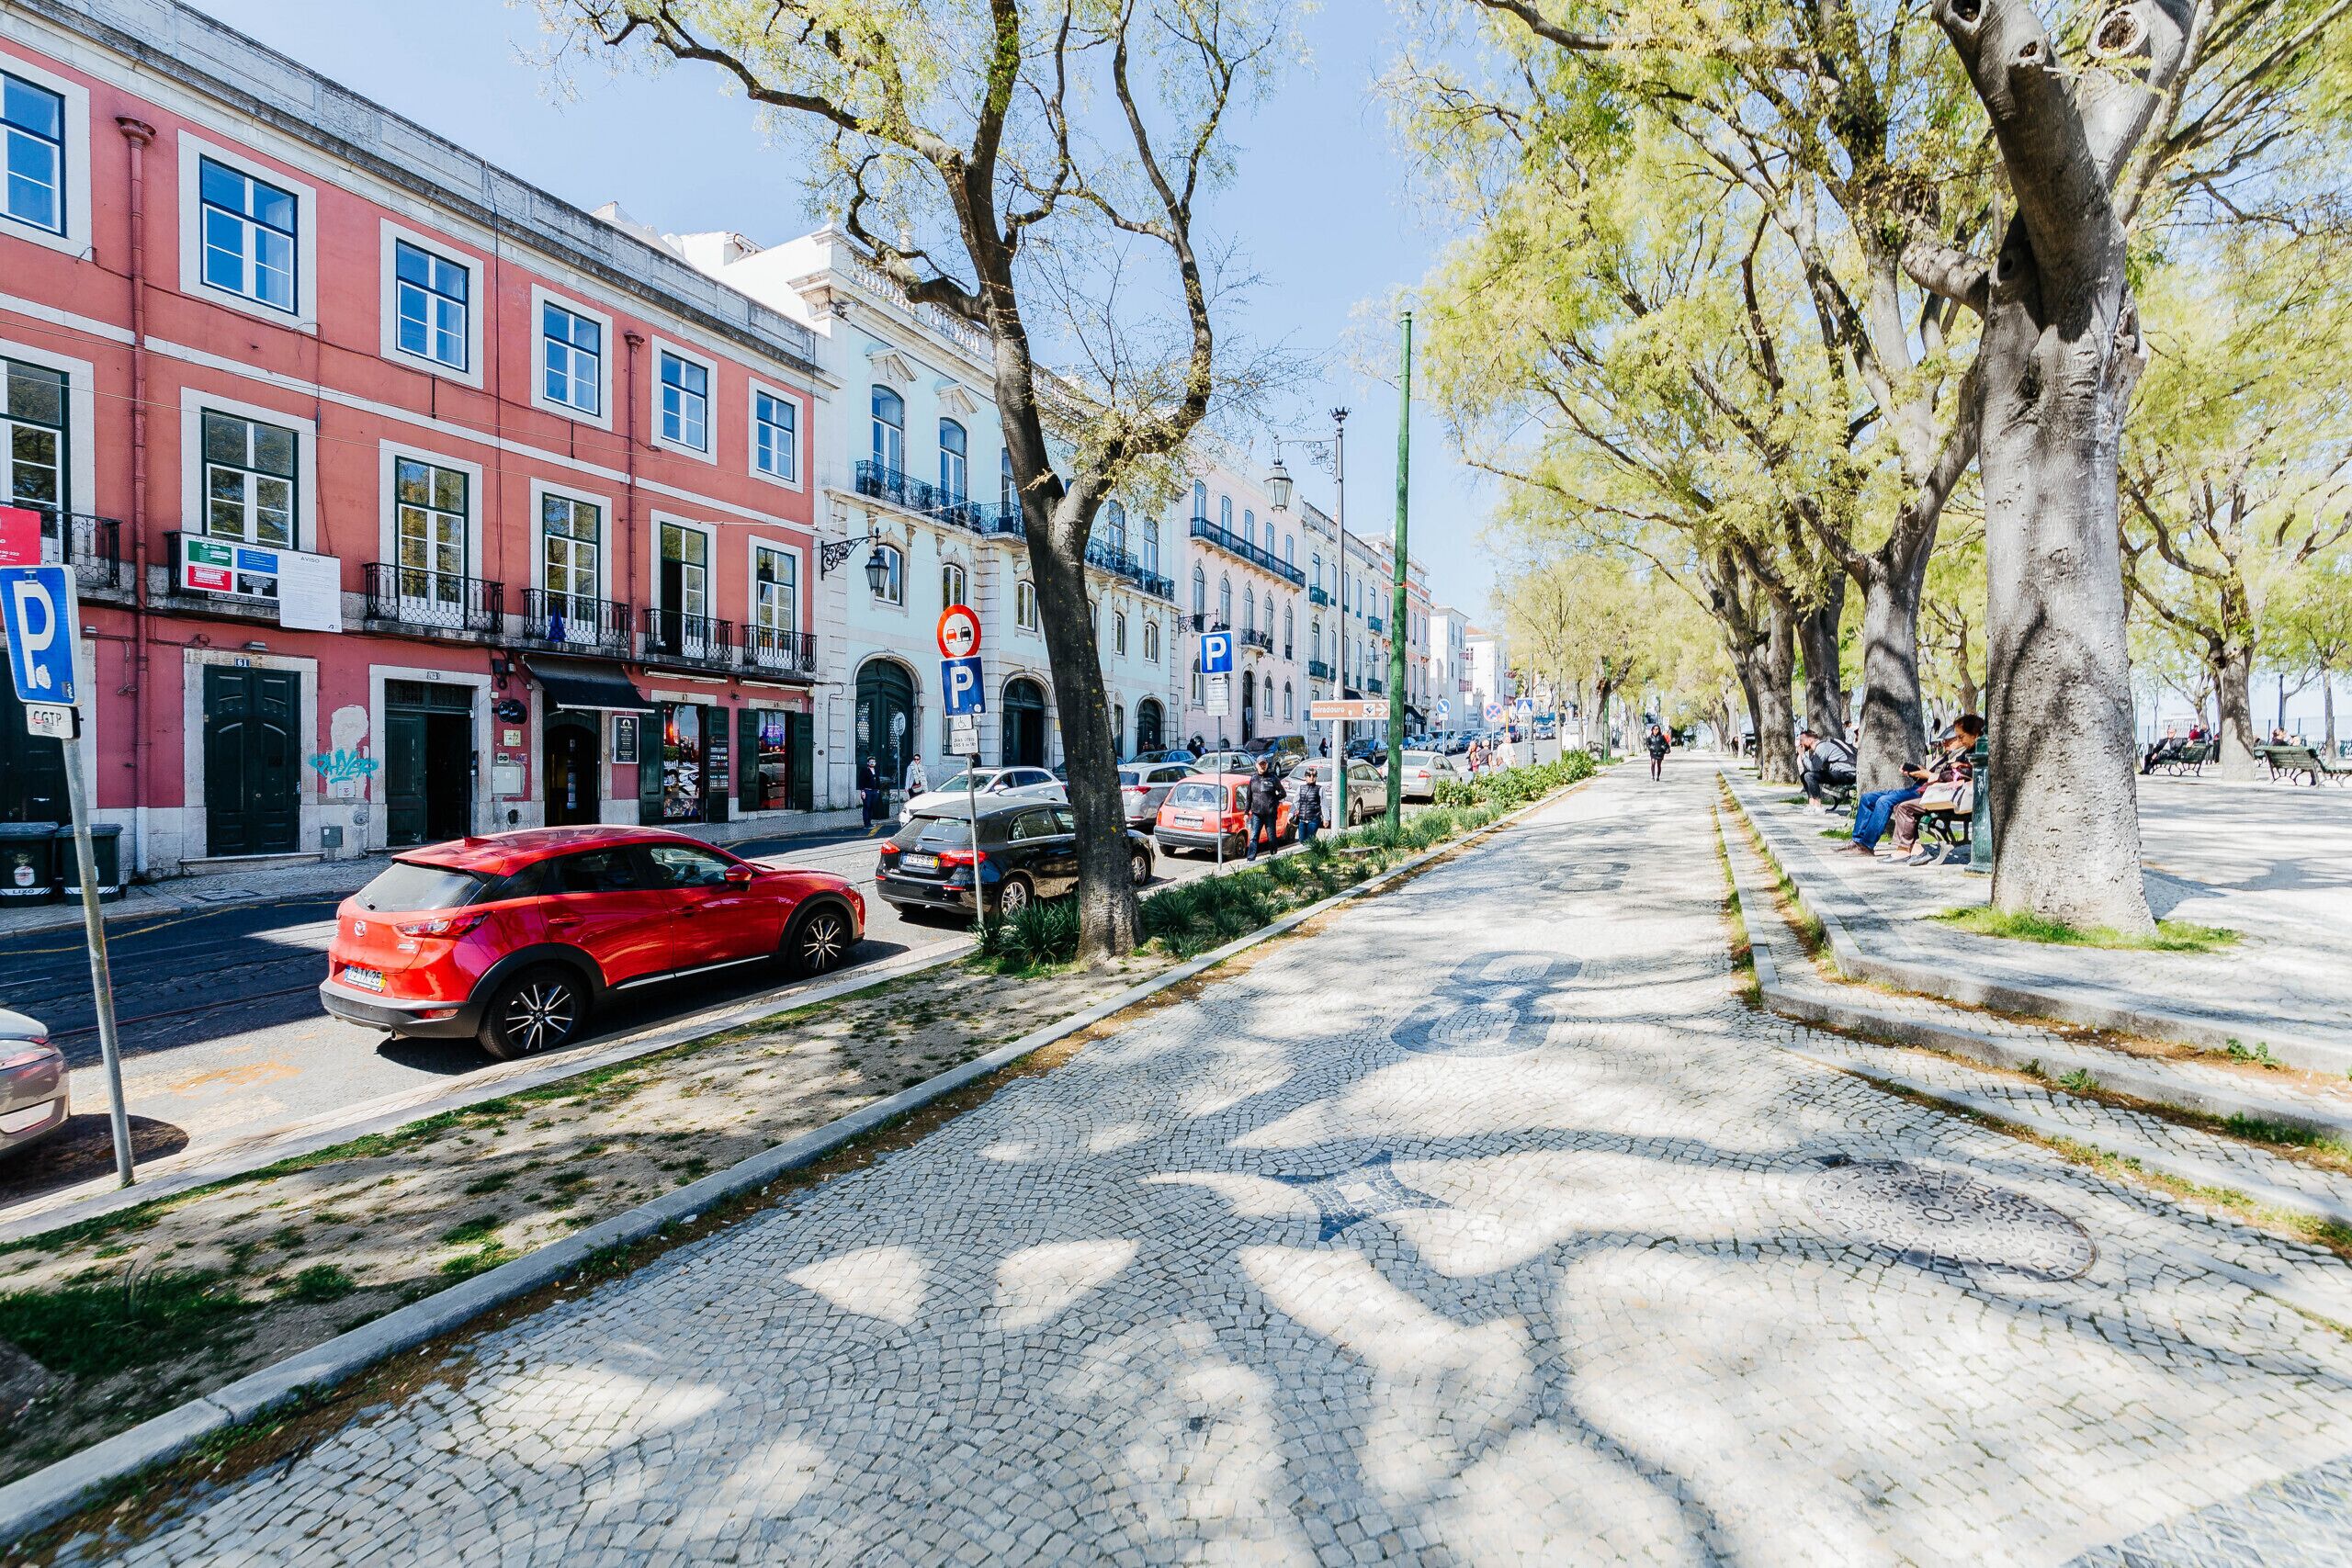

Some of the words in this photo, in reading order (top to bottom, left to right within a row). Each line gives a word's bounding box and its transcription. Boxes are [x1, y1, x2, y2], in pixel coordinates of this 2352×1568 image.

[300, 556, 321, 564] AVISO
[13, 581, 56, 689] P
[237, 659, 249, 667] 61
[1205, 636, 1227, 671] P
[950, 665, 974, 709] P
[1312, 705, 1345, 714] miradouro
